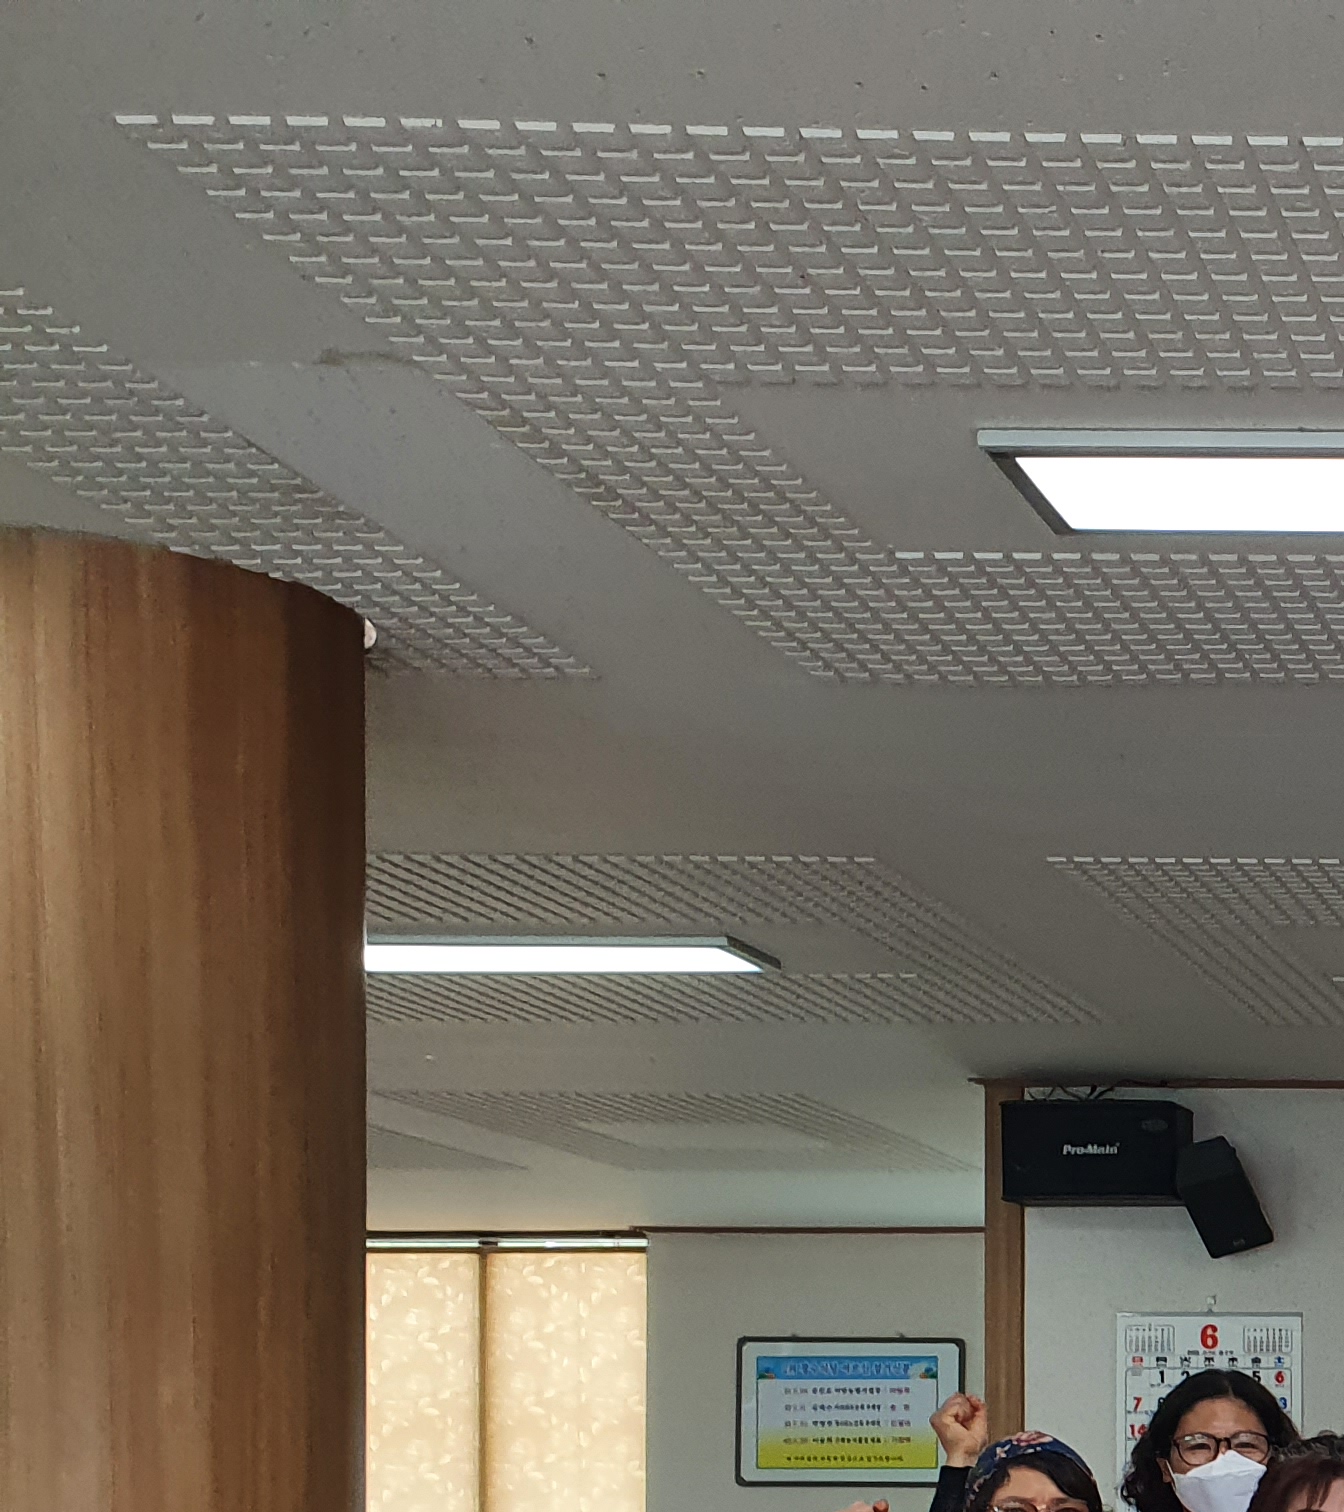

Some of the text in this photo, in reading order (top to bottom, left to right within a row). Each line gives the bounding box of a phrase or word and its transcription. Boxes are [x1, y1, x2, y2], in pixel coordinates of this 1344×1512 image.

[1200, 1324, 1219, 1350] 6
[1158, 1371, 1166, 1384] 1
[1274, 1371, 1285, 1384] 6
[1132, 1397, 1143, 1412] 7
